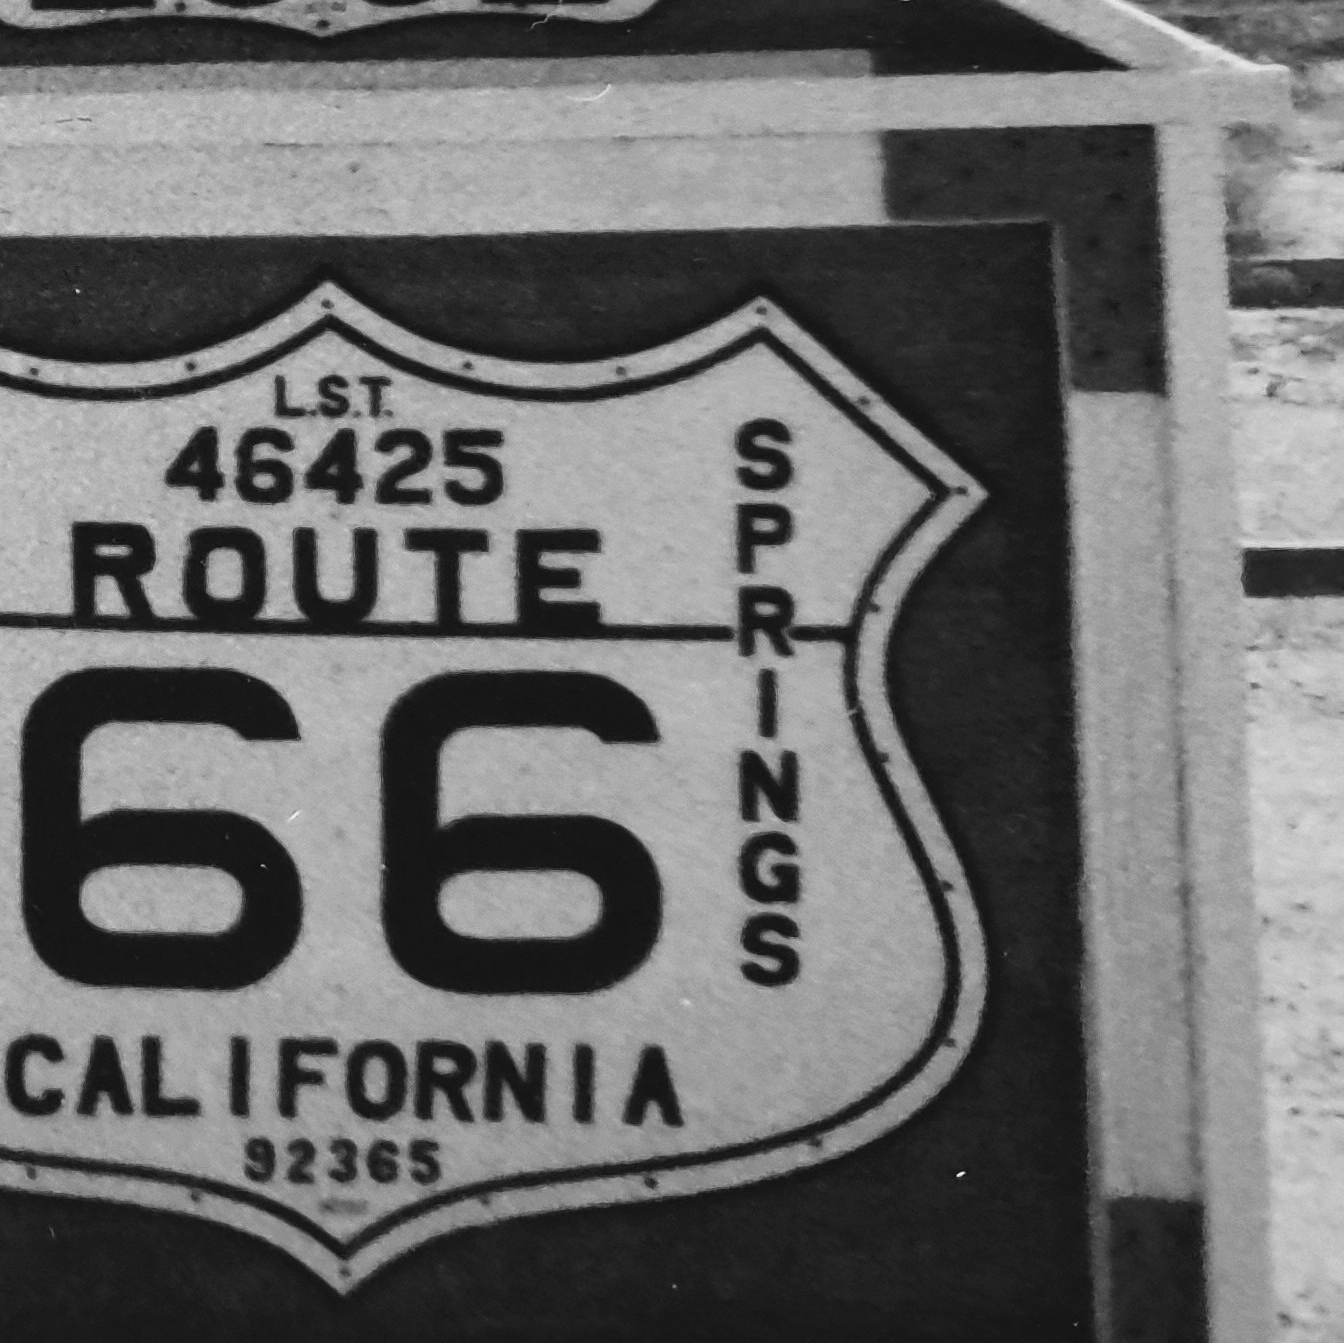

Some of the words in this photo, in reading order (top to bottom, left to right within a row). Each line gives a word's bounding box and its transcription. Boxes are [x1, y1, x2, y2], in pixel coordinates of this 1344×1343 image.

[165, 426, 505, 507] 46425
[71, 521, 602, 631] ROUTE
[734, 418, 802, 989] SPRINGS
[19, 665, 663, 998] 66
[4, 1033, 686, 1129] CALIFORNIA
[244, 1136, 443, 1187] 92365
